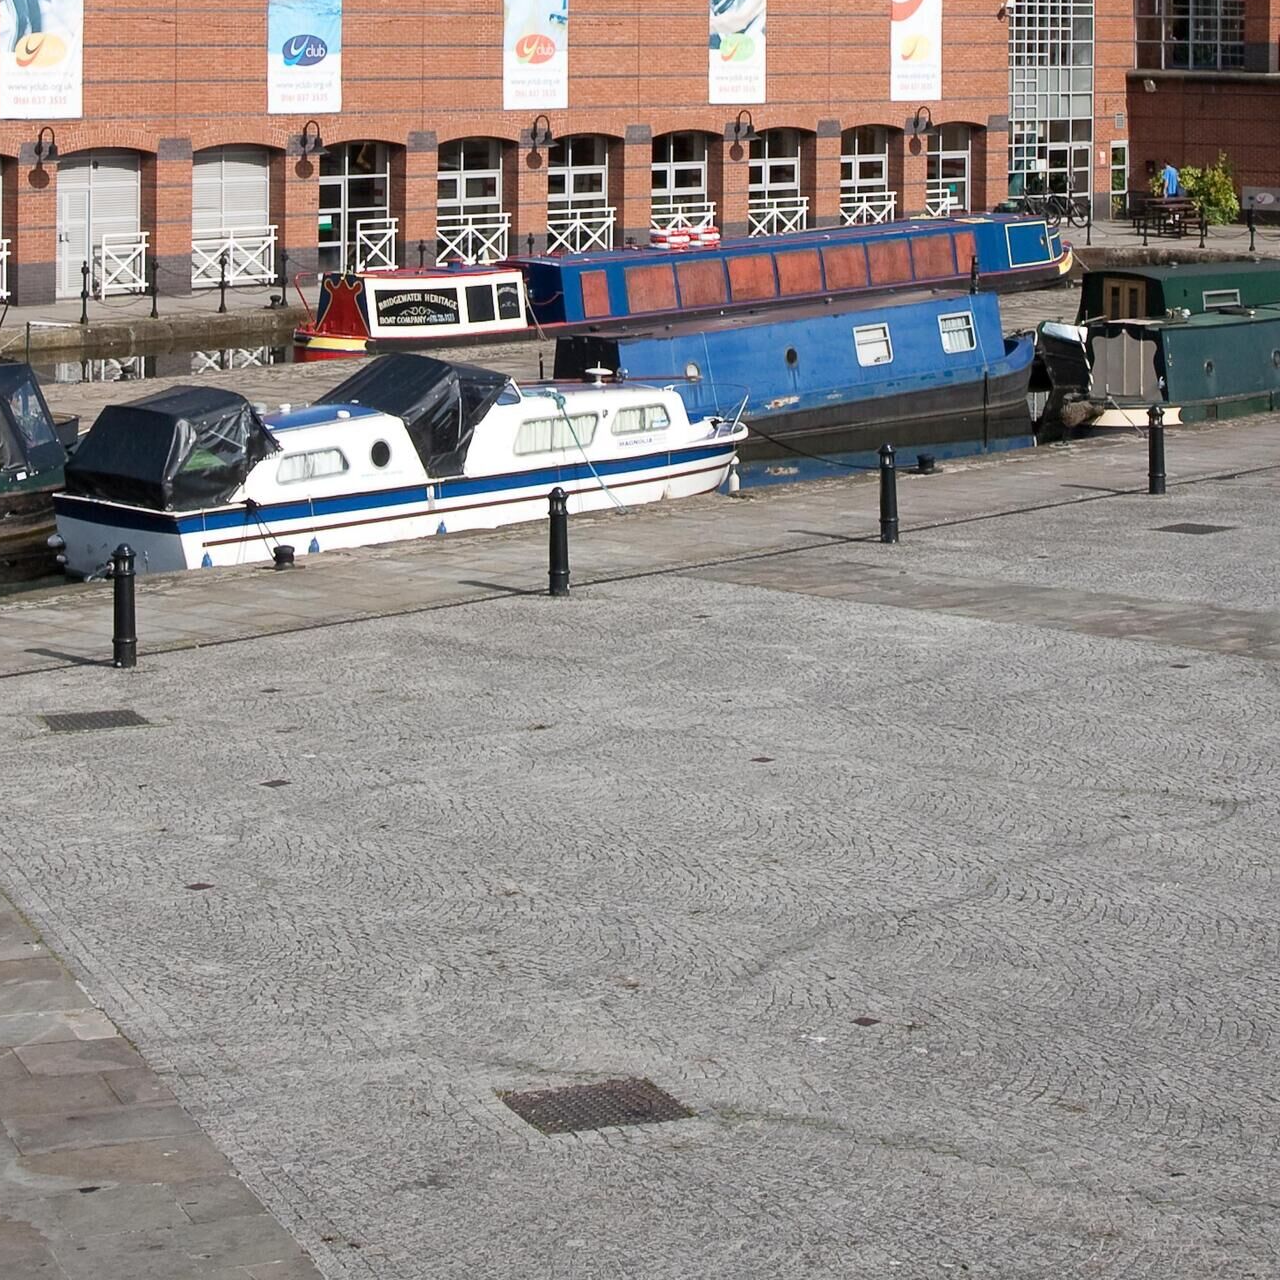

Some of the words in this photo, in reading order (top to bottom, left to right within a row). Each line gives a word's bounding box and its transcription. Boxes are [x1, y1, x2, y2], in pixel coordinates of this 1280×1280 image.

[378, 293, 422, 310] BRIDGEWATER
[424, 293, 458, 310] HERITAGE
[379, 316, 396, 325] BOAT
[396, 315, 426, 325] COMPANY
